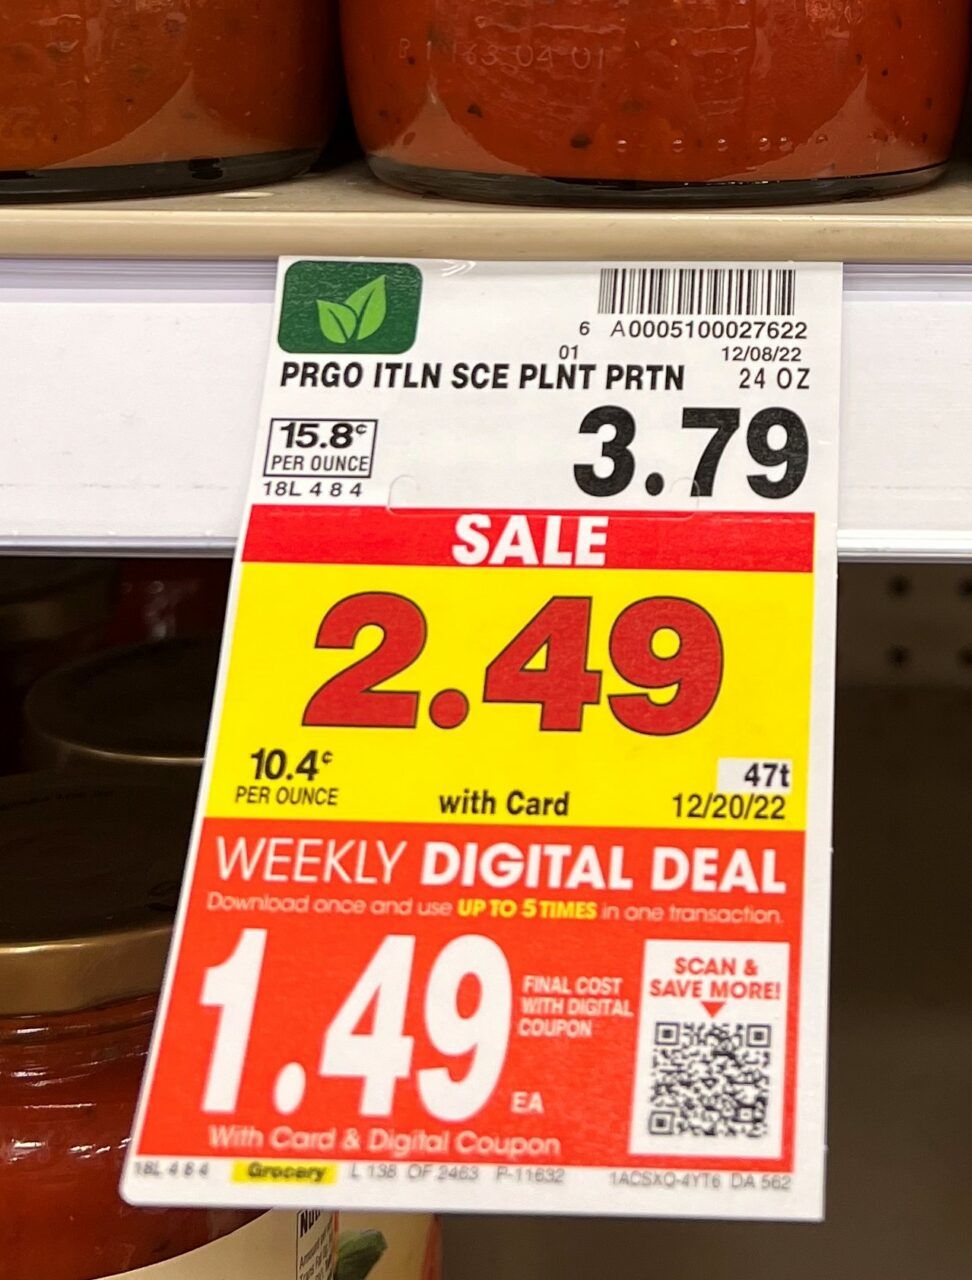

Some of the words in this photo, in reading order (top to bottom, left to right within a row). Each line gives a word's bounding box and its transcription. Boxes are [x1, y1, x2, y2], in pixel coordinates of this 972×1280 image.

[578, 321, 590, 337] 6
[610, 320, 808, 340] A0005100027622
[558, 345, 579, 361] 01
[721, 346, 802, 362] 12/08/22
[279, 361, 363, 388] PRGO
[372, 362, 442, 389] ITLN
[450, 362, 509, 390] SCE
[517, 363, 596, 391] PLNT
[604, 365, 685, 391] PRTN
[738, 368, 766, 390] 24
[776, 369, 810, 390] OZ
[271, 455, 305, 470] PER
[310, 455, 370, 471] OUNCE
[572, 404, 810, 501] 3.79
[262, 481, 301, 496] 18L
[452, 513, 609, 568] SALE
[301, 590, 725, 737] 2.49
[743, 762, 791, 789] 47t
[235, 785, 270, 804] PER
[276, 786, 339, 806] OUNCE
[438, 790, 499, 815] with
[505, 791, 570, 817] Card
[672, 793, 786, 821] 12/20/22
[215, 836, 407, 885] WEEKLY
[420, 841, 635, 891] DIGITAL
[650, 846, 786, 894] DEAL
[207, 891, 309, 912] Download
[313, 897, 366, 915] once
[371, 898, 412, 916] and
[418, 901, 453, 917] use
[458, 899, 487, 917] UP
[490, 899, 517, 918] TO
[540, 900, 598, 920] TIMES
[602, 902, 619, 921] in
[624, 905, 665, 922] one
[674, 957, 736, 976] SCAN
[743, 959, 758, 976] &
[522, 975, 572, 995] FINAL
[575, 976, 624, 995] COST
[650, 979, 702, 998] SAVE
[709, 980, 781, 1000] MORE!
[521, 996, 563, 1015] WITH
[566, 999, 635, 1017] DIGITAL
[200, 927, 513, 1123] 1.49
[518, 1018, 593, 1038] COUPON
[511, 1092, 545, 1116] EA
[208, 1124, 264, 1149] With
[269, 1125, 336, 1151] Card
[341, 1127, 361, 1151] &
[367, 1127, 450, 1158] Digital
[454, 1130, 561, 1159] Coupon
[247, 1161, 329, 1182] Grocery
